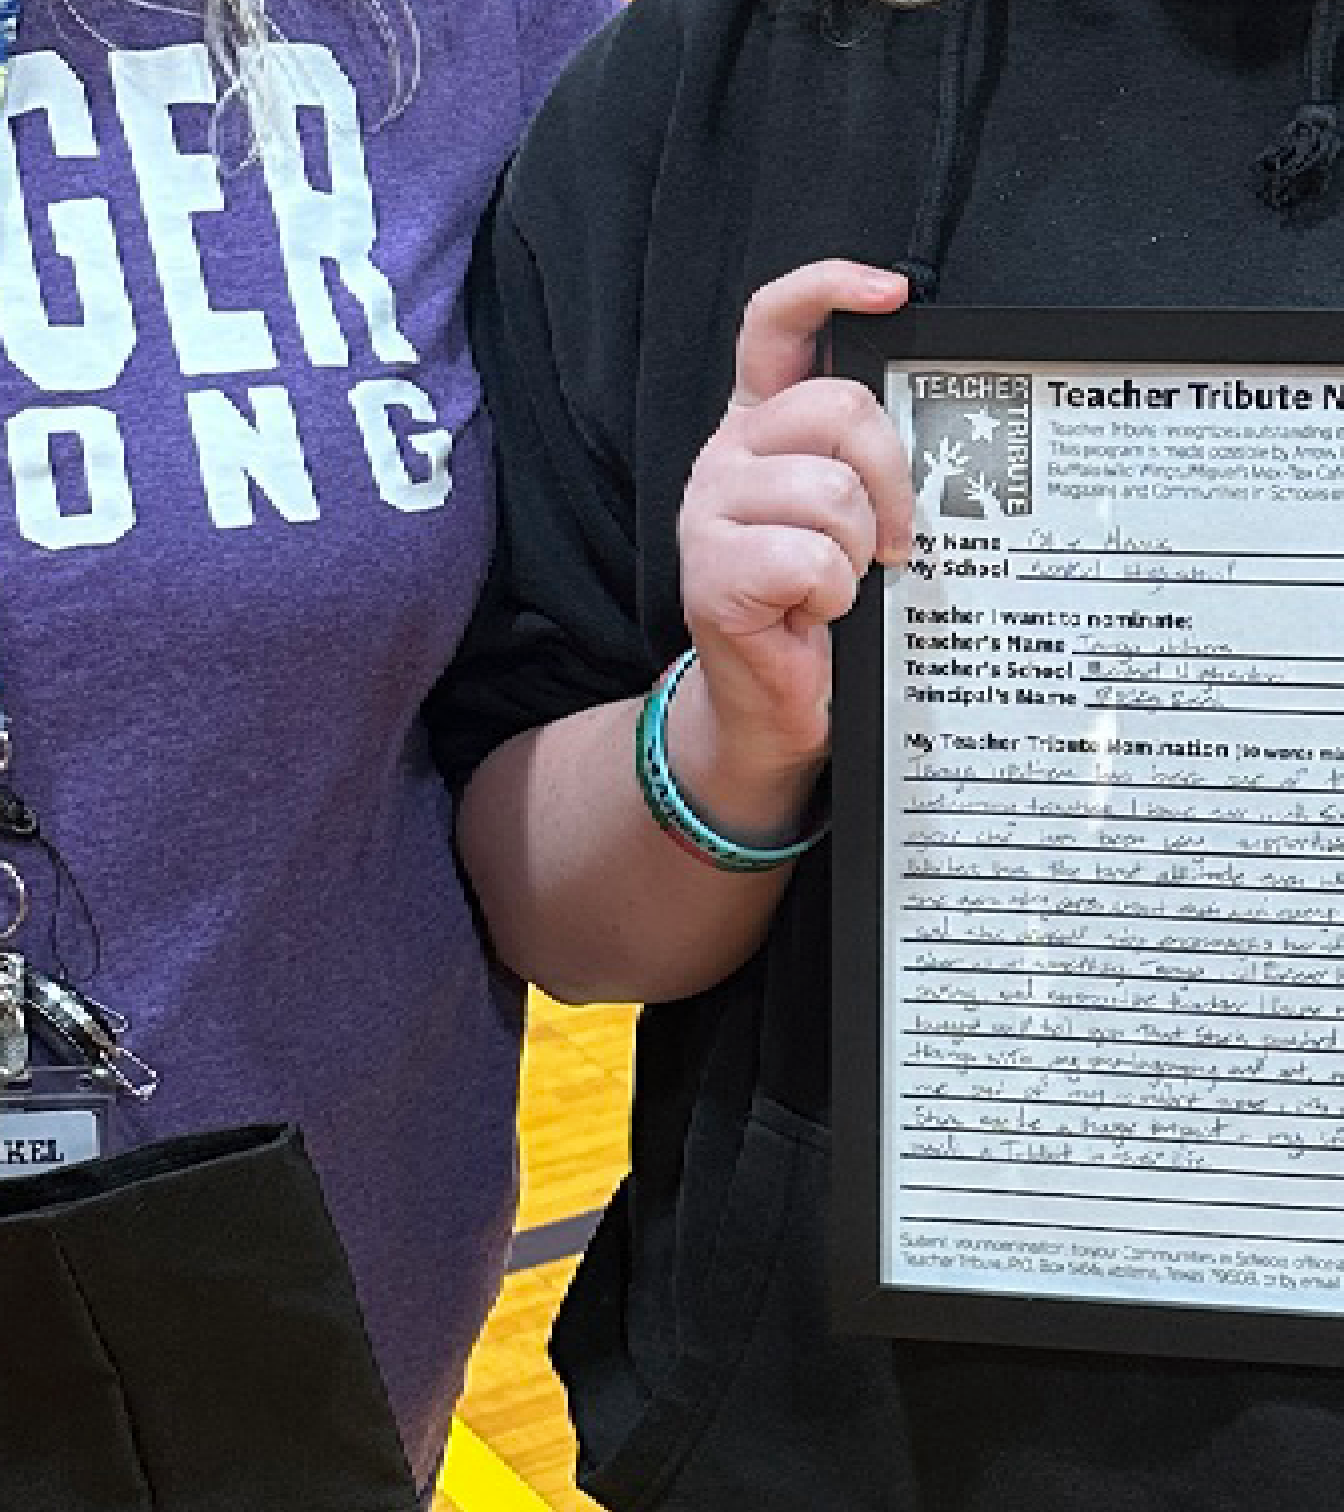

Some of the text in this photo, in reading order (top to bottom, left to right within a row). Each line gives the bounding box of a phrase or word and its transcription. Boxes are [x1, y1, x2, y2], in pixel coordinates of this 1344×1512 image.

[914, 374, 1029, 400] TEACHER
[1047, 380, 1180, 409] Teacher
[1188, 382, 1313, 410] Tribute
[1007, 403, 1029, 516] TRIBUTE
[943, 532, 1002, 552] Name
[906, 557, 1010, 581] My School
[905, 606, 984, 627] Teacher
[999, 609, 1055, 628] want
[1058, 610, 1081, 629] to
[1086, 610, 1194, 631] nominate:
[905, 631, 1066, 654] Teacher's Name
[905, 658, 1002, 679] Teacher's
[1006, 660, 1074, 682] School
[905, 685, 1010, 709] Principal's
[1015, 687, 1078, 707] Name
[905, 731, 936, 754] My
[940, 731, 1020, 752] Teacher
[1026, 734, 1099, 755] Tribute
[1105, 736, 1230, 759] Nomination
